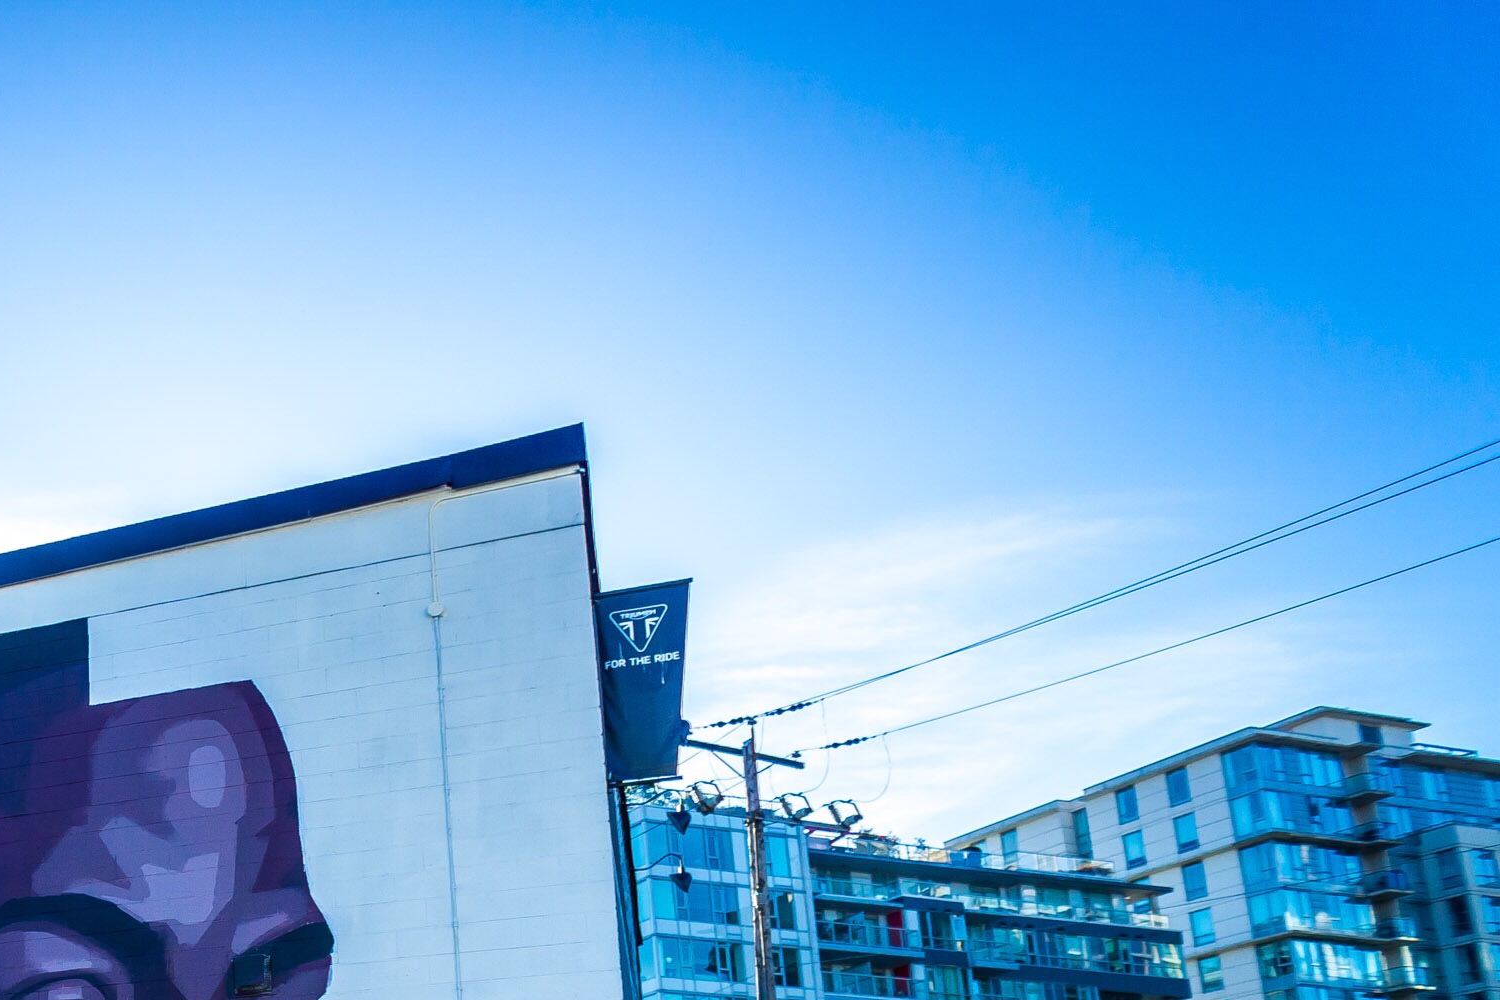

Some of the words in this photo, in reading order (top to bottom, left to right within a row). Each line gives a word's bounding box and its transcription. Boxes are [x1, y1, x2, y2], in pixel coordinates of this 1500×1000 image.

[605, 659, 626, 670] FOR
[629, 655, 651, 666] THE
[654, 651, 680, 663] RIDE
